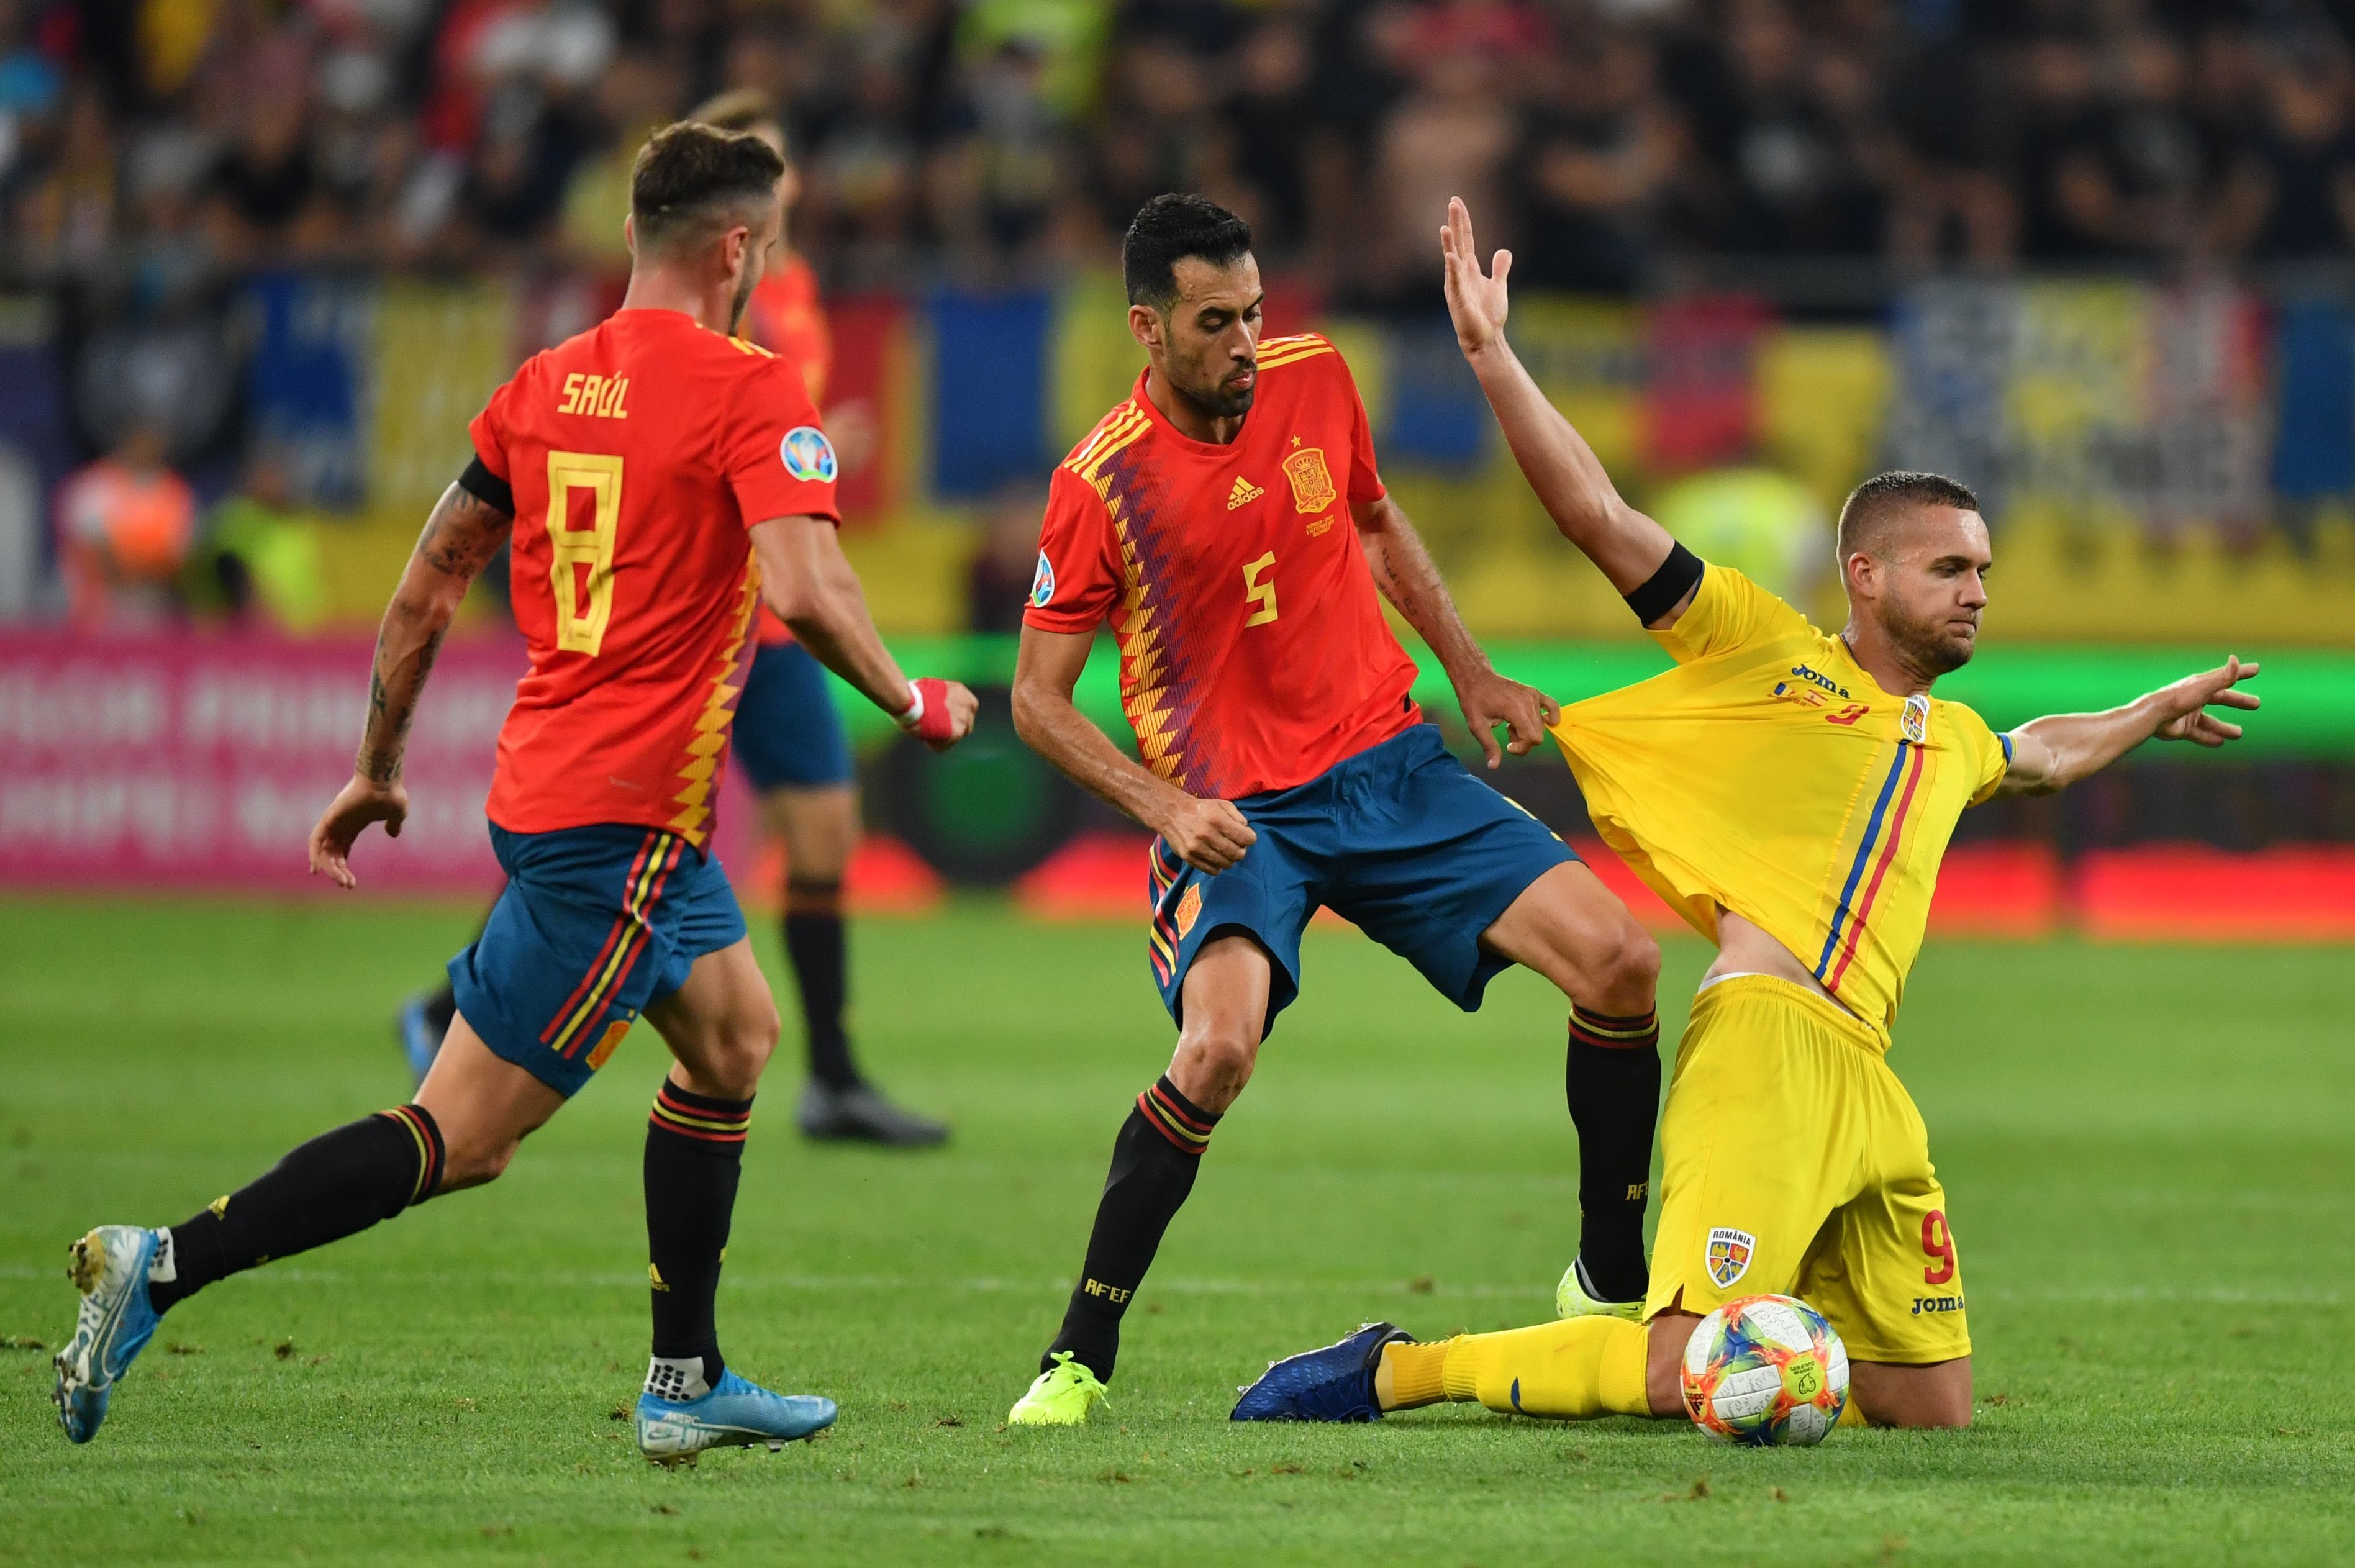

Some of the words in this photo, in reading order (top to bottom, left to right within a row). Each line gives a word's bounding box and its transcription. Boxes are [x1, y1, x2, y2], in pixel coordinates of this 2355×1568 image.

[557, 370, 629, 419] SAÚL
[1227, 487, 1264, 510] adidas
[545, 450, 624, 658] 8
[1242, 551, 1278, 628] 5
[1712, 1230, 1751, 1246] ROMÂNIA
[1920, 1209, 1954, 1285] 9
